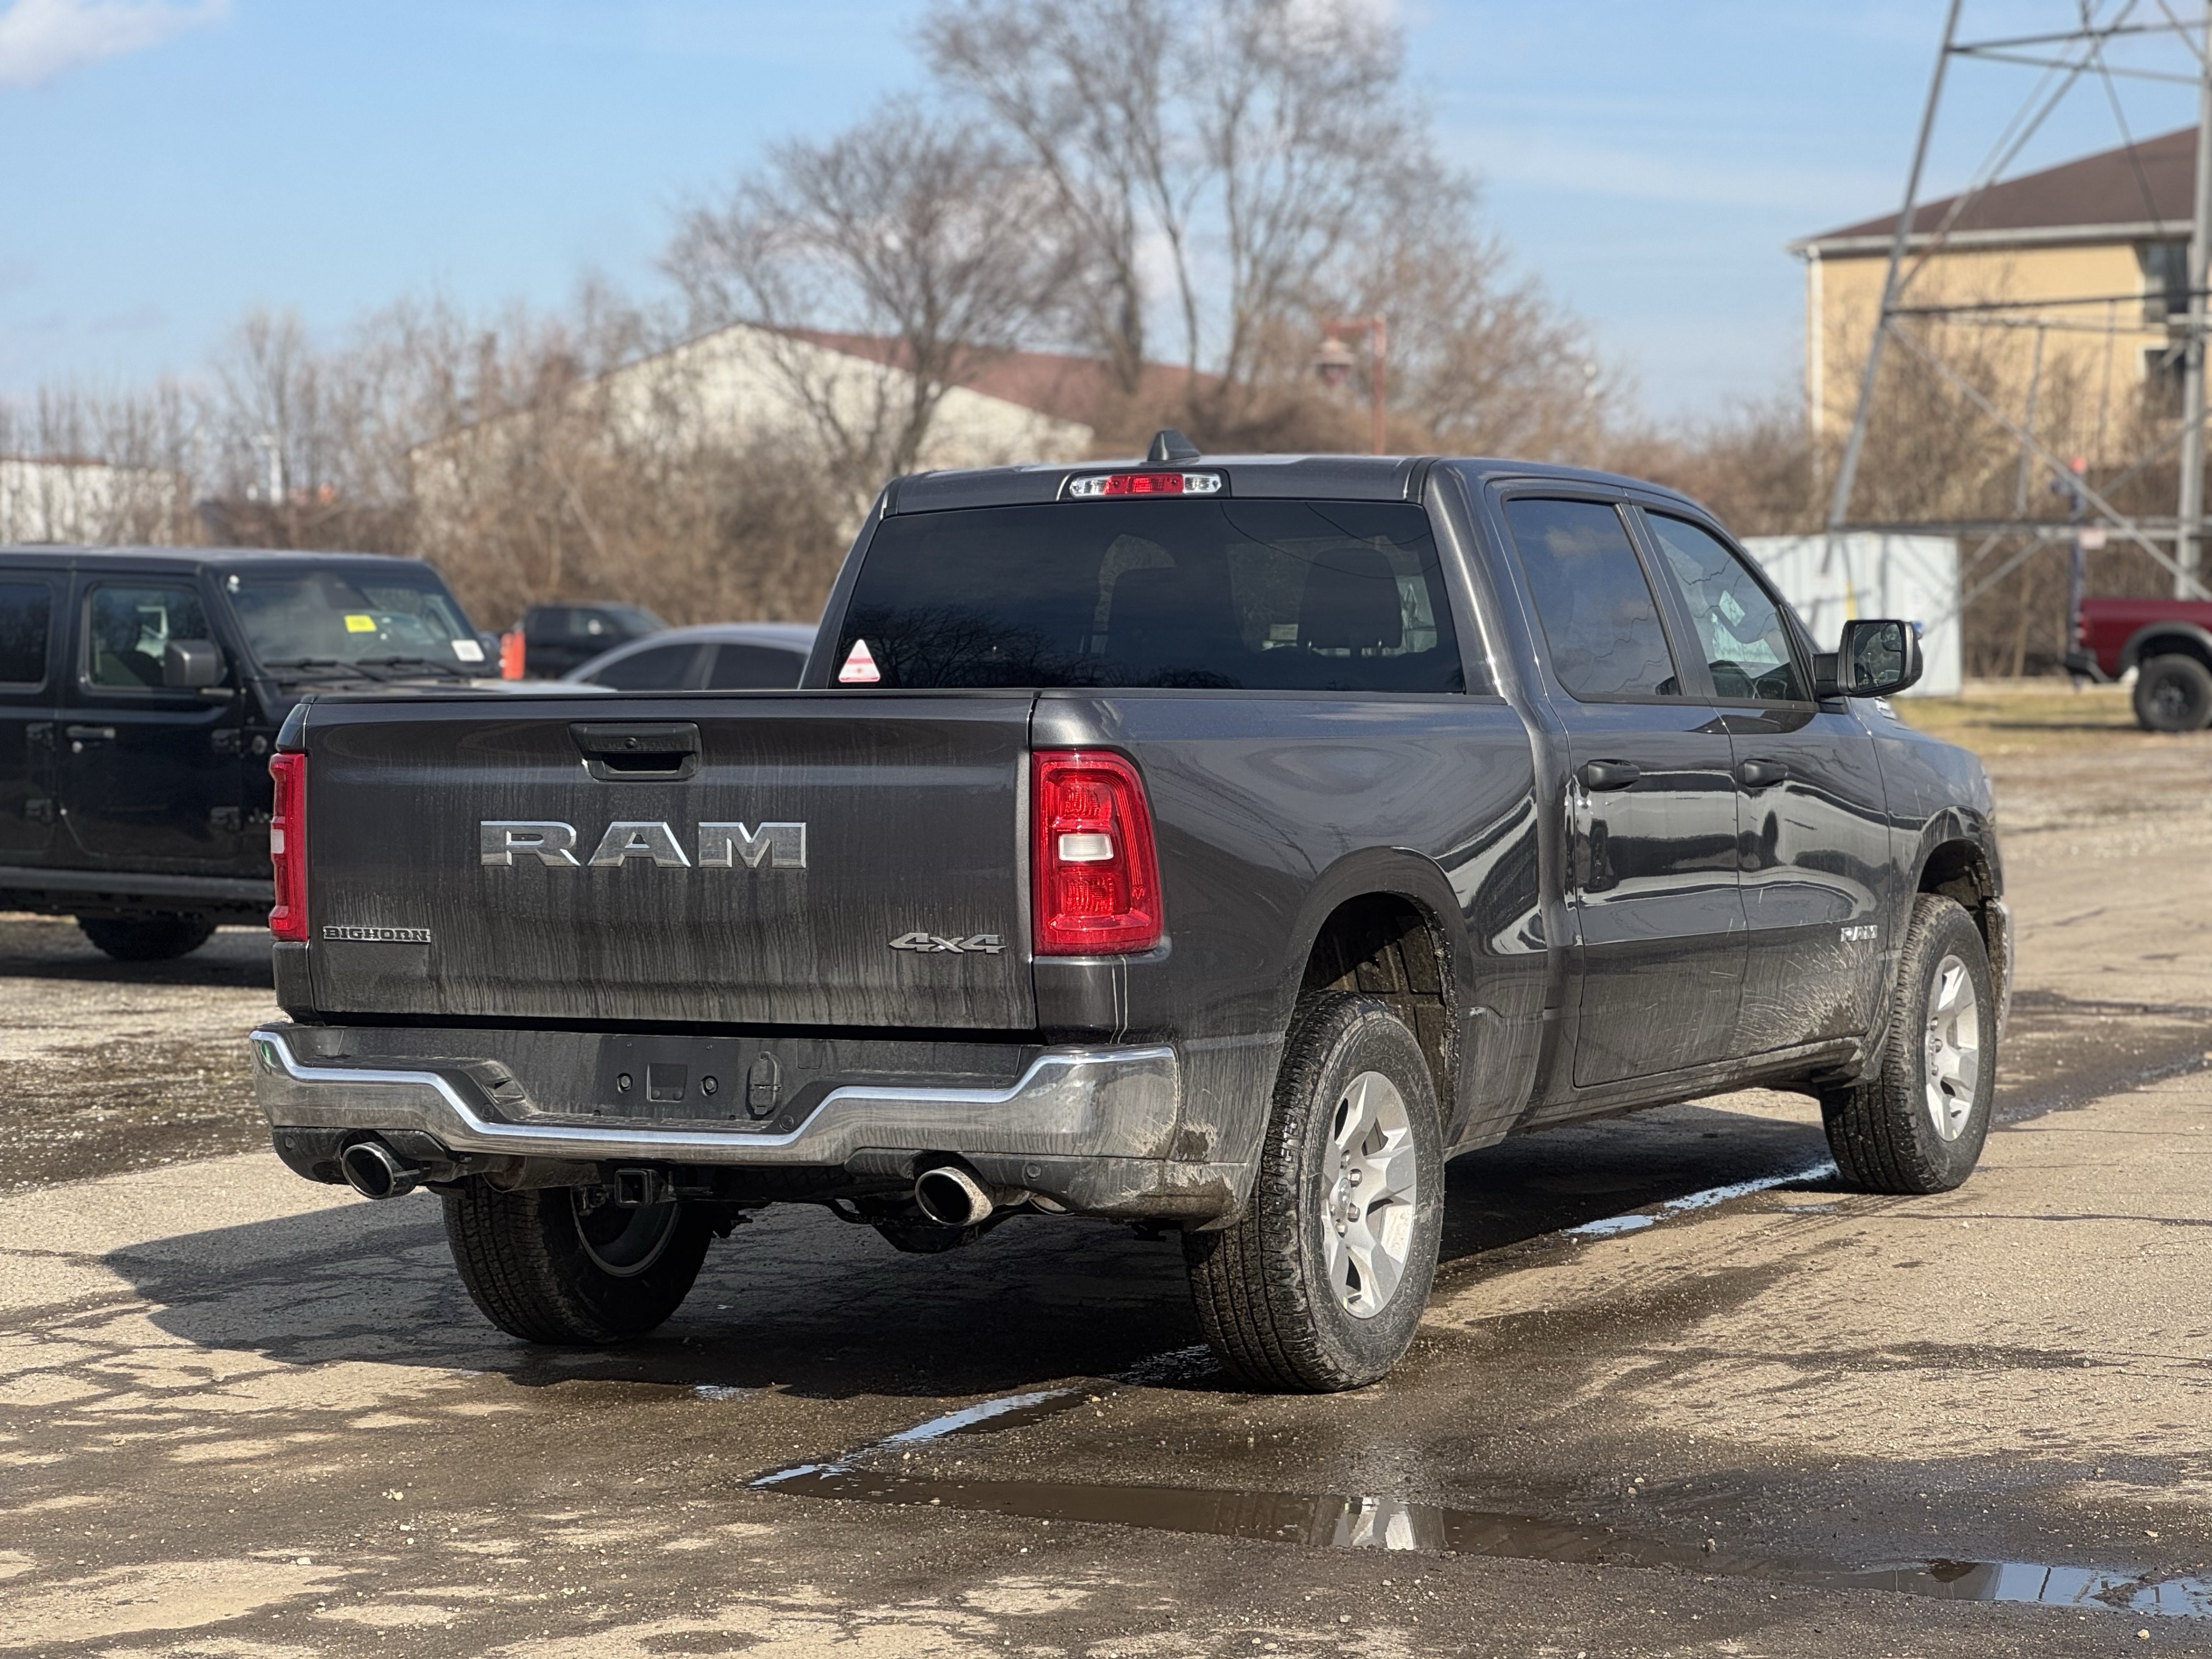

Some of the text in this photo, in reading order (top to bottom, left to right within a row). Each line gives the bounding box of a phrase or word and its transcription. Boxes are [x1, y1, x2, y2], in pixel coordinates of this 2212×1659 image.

[481, 821, 806, 868] RAM
[324, 926, 431, 943] BIGHORN
[1840, 925, 1877, 942] RAM
